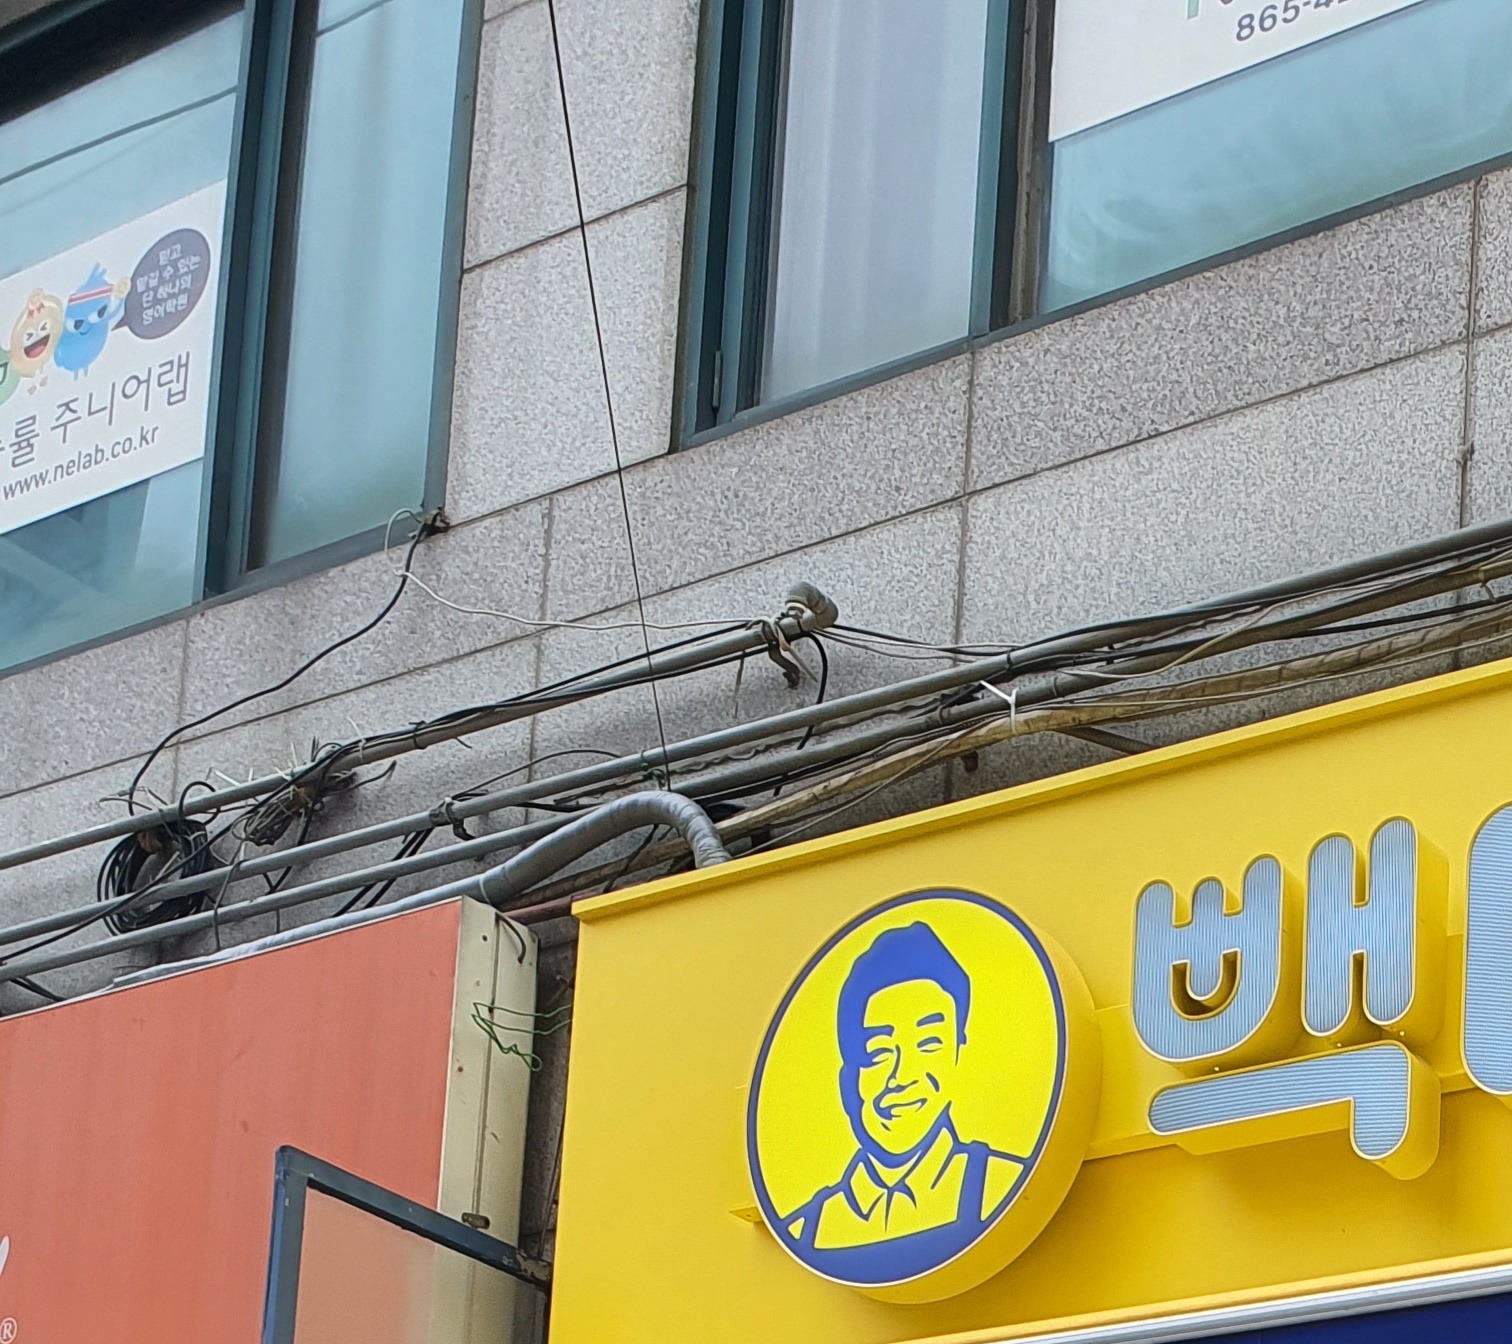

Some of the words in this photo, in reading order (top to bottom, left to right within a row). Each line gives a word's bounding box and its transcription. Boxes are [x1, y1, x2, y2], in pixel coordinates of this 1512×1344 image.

[0, 413, 40, 468] 률
[50, 351, 191, 444] 주니어랩
[2, 425, 160, 501] www.nelab.co.kr
